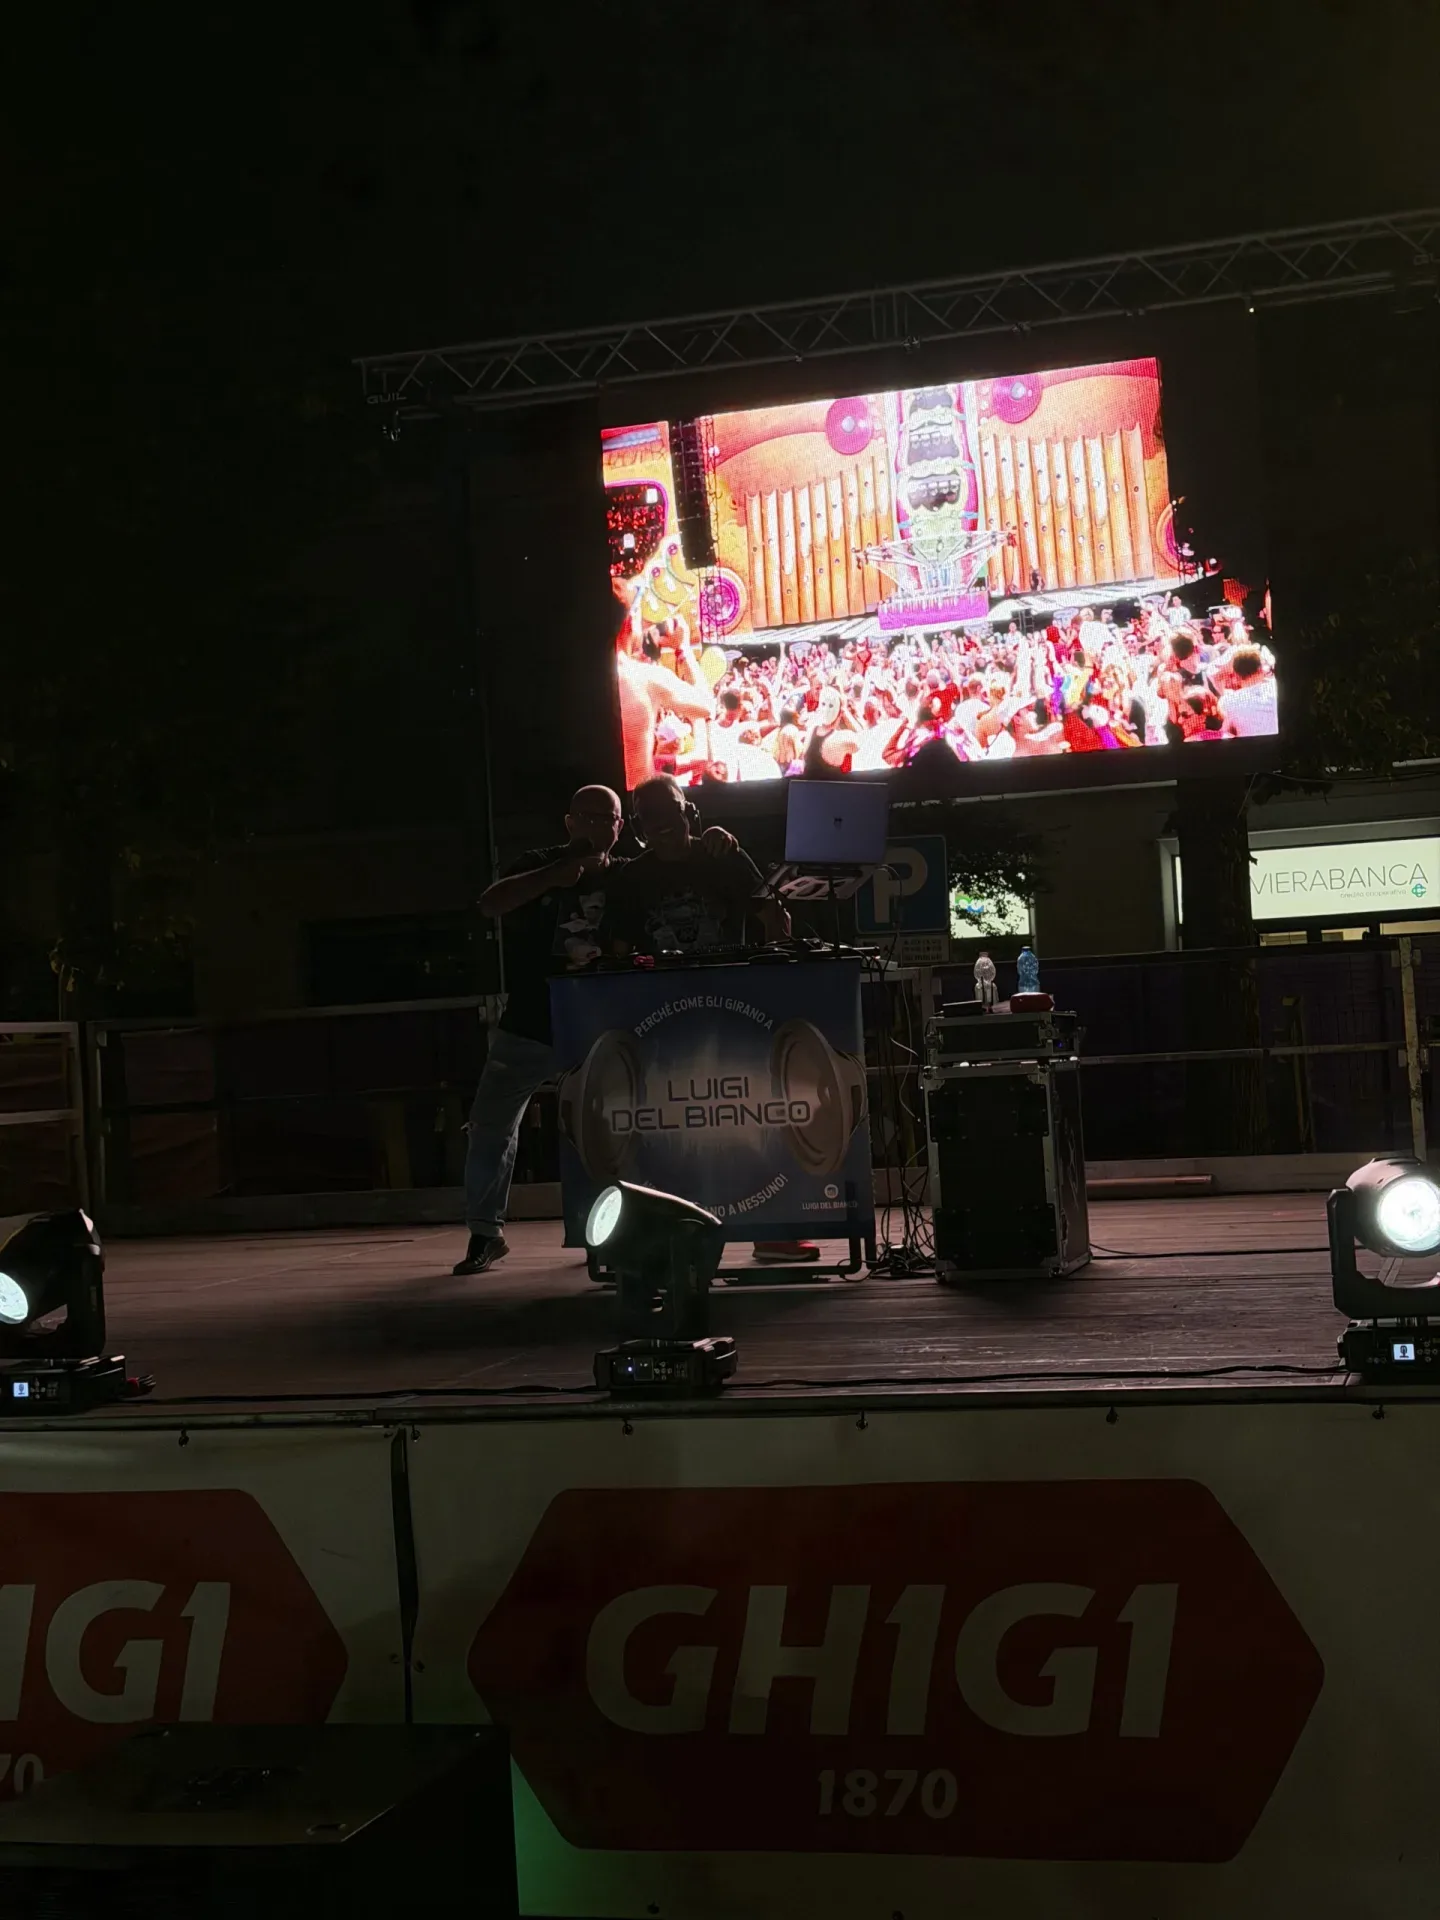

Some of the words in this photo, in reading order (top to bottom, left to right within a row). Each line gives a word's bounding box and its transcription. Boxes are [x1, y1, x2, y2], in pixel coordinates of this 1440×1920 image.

[873, 846, 928, 924] P
[673, 996, 705, 1013] COME
[705, 996, 723, 1008] GLI
[724, 998, 767, 1024] GIRANO
[764, 1019, 774, 1031] A
[668, 1076, 749, 1101] LUIGI
[611, 1107, 680, 1131] DEL
[685, 1100, 811, 1128] BIANCO
[728, 1204, 737, 1216] A
[736, 1172, 789, 1213] NESSUNO!
[817, 1767, 958, 1819] 1870
